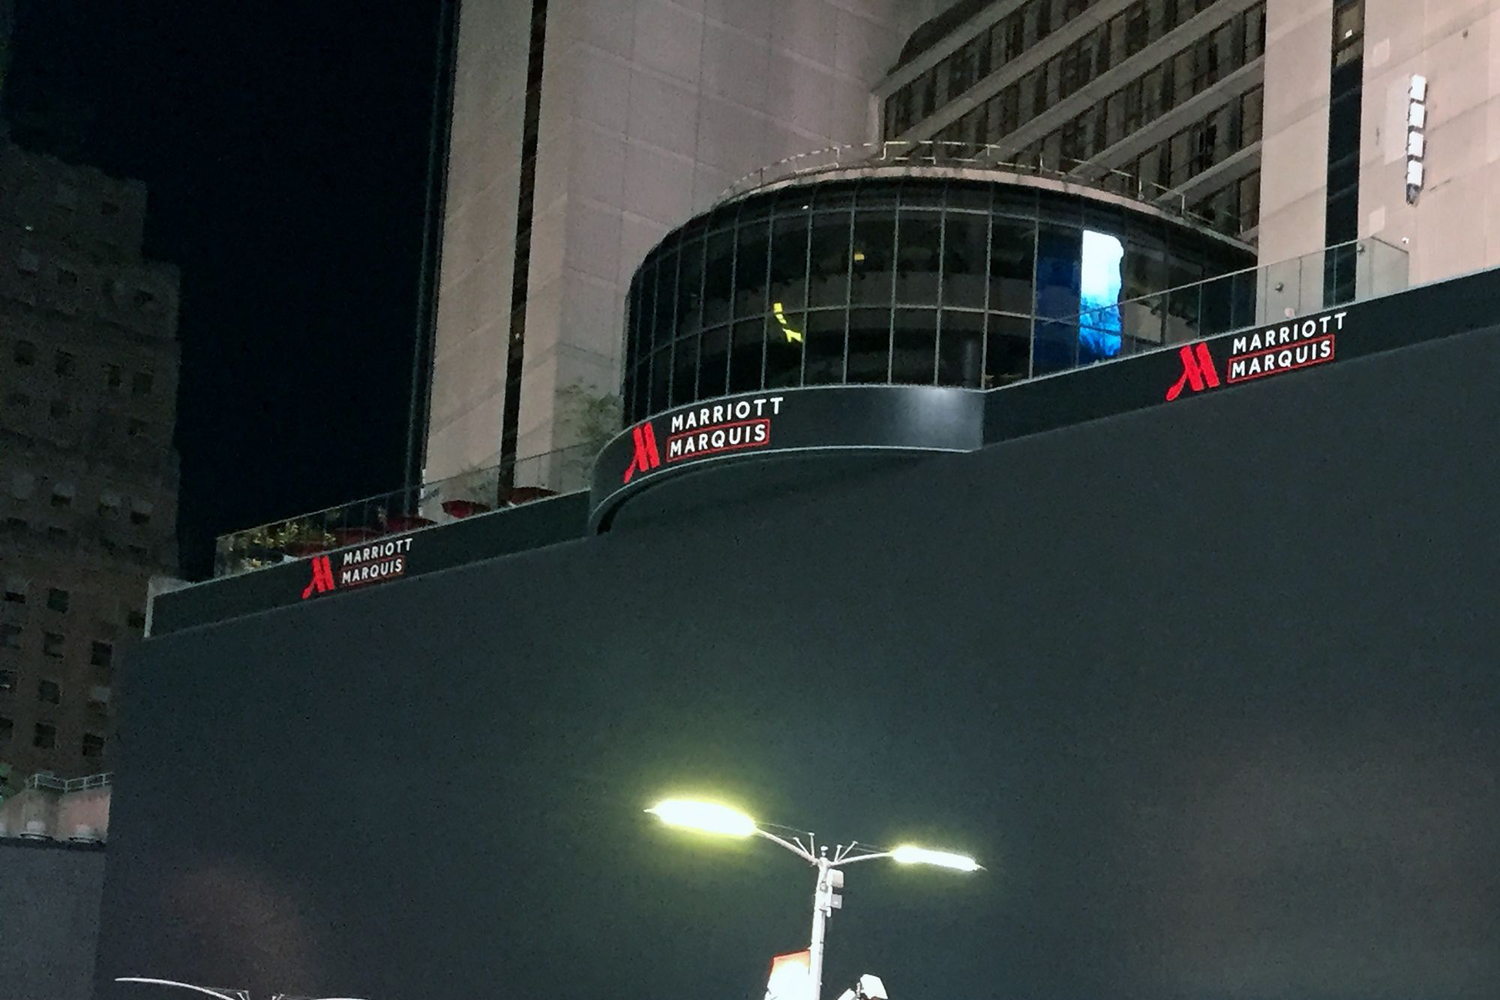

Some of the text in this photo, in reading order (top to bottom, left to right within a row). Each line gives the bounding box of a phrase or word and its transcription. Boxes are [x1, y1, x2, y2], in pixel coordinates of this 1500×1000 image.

[1232, 312, 1347, 353] MARRIOTT
[1230, 340, 1333, 378] MARQUIS
[669, 396, 784, 432] MARRIOTT
[669, 421, 767, 457] MARQUIS
[341, 539, 414, 566] MARRIOTT
[341, 557, 403, 583] MARQUIS
